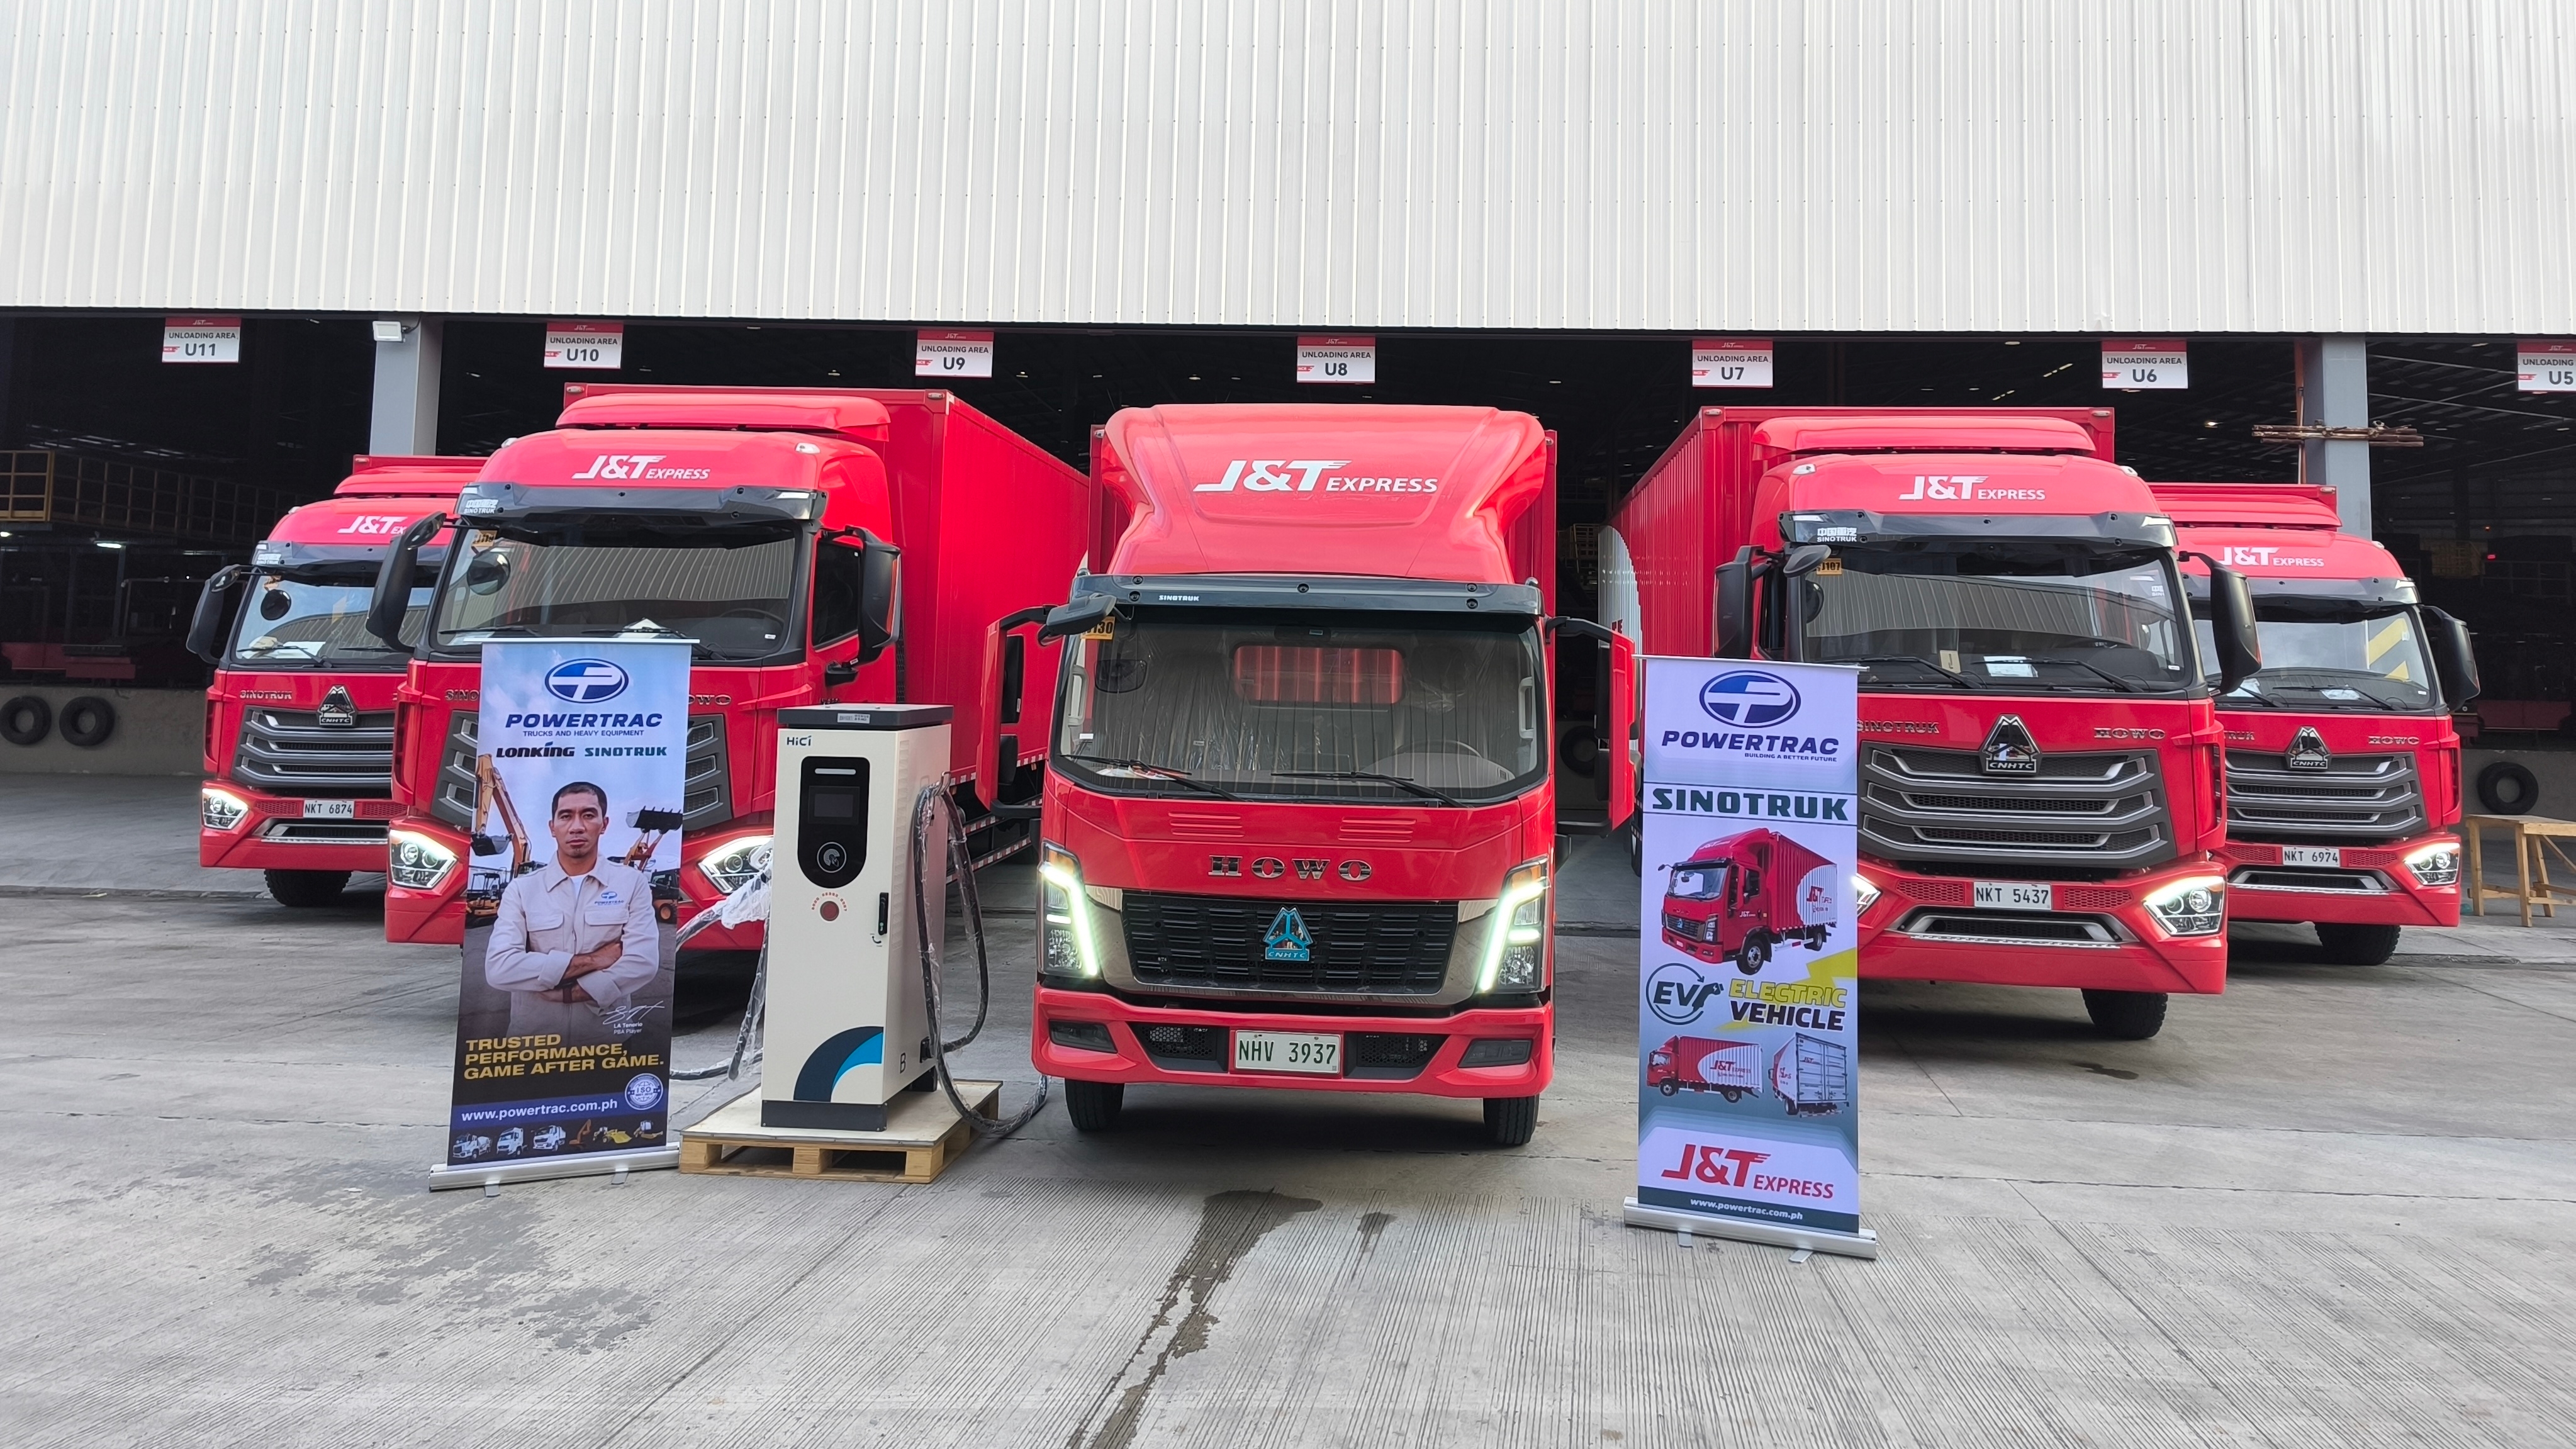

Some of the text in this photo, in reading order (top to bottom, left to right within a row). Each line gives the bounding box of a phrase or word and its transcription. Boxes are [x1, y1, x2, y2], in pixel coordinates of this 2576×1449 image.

[185, 344, 216, 356] U11
[567, 349, 599, 361] U10
[943, 357, 965, 370] U9
[1325, 363, 1347, 376] U8
[1722, 367, 1744, 380] U7
[2132, 369, 2157, 383] U6
[2549, 371, 2573, 384] U5
[571, 455, 710, 479] J&T EXPRESS
[1192, 460, 1438, 493] J&T EXPRESS
[1898, 476, 2046, 500] J&T EXPRESS
[337, 516, 408, 534] J&T
[2219, 547, 2324, 567] J&T EXPRESS
[445, 689, 479, 701] SINO
[505, 713, 663, 728] POWERTRAC
[2094, 727, 2166, 739] HOWO
[2368, 736, 2419, 745] HOWO
[1662, 730, 1839, 755] POWERTRAC
[585, 747, 668, 756] SINOTRUK
[1990, 761, 2034, 770] CNHTC
[305, 803, 352, 814] NKT 6874
[1652, 788, 1849, 821] SINOTRUK
[2284, 850, 2338, 863] NKT 6974
[1208, 854, 1372, 881] HOWO
[1976, 887, 2049, 904] NKT 5437
[1268, 951, 1306, 959] CNHTC
[1728, 978, 1847, 1008] ELECTRIC
[1730, 1000, 1846, 1031] VEHICLE
[466, 1034, 561, 1051] TRUSTED
[465, 1043, 628, 1066] PERFORMANCE,
[1239, 1039, 1336, 1065] NHV 3937
[464, 1055, 664, 1080] GAME AFTER GAME.
[900, 1052, 906, 1074] B
[461, 1099, 618, 1122] www.powertrac.com.ph
[1661, 1143, 1834, 1199] J&T EXPRESS
[1690, 1198, 1803, 1220] www.powertrac.com.ph
